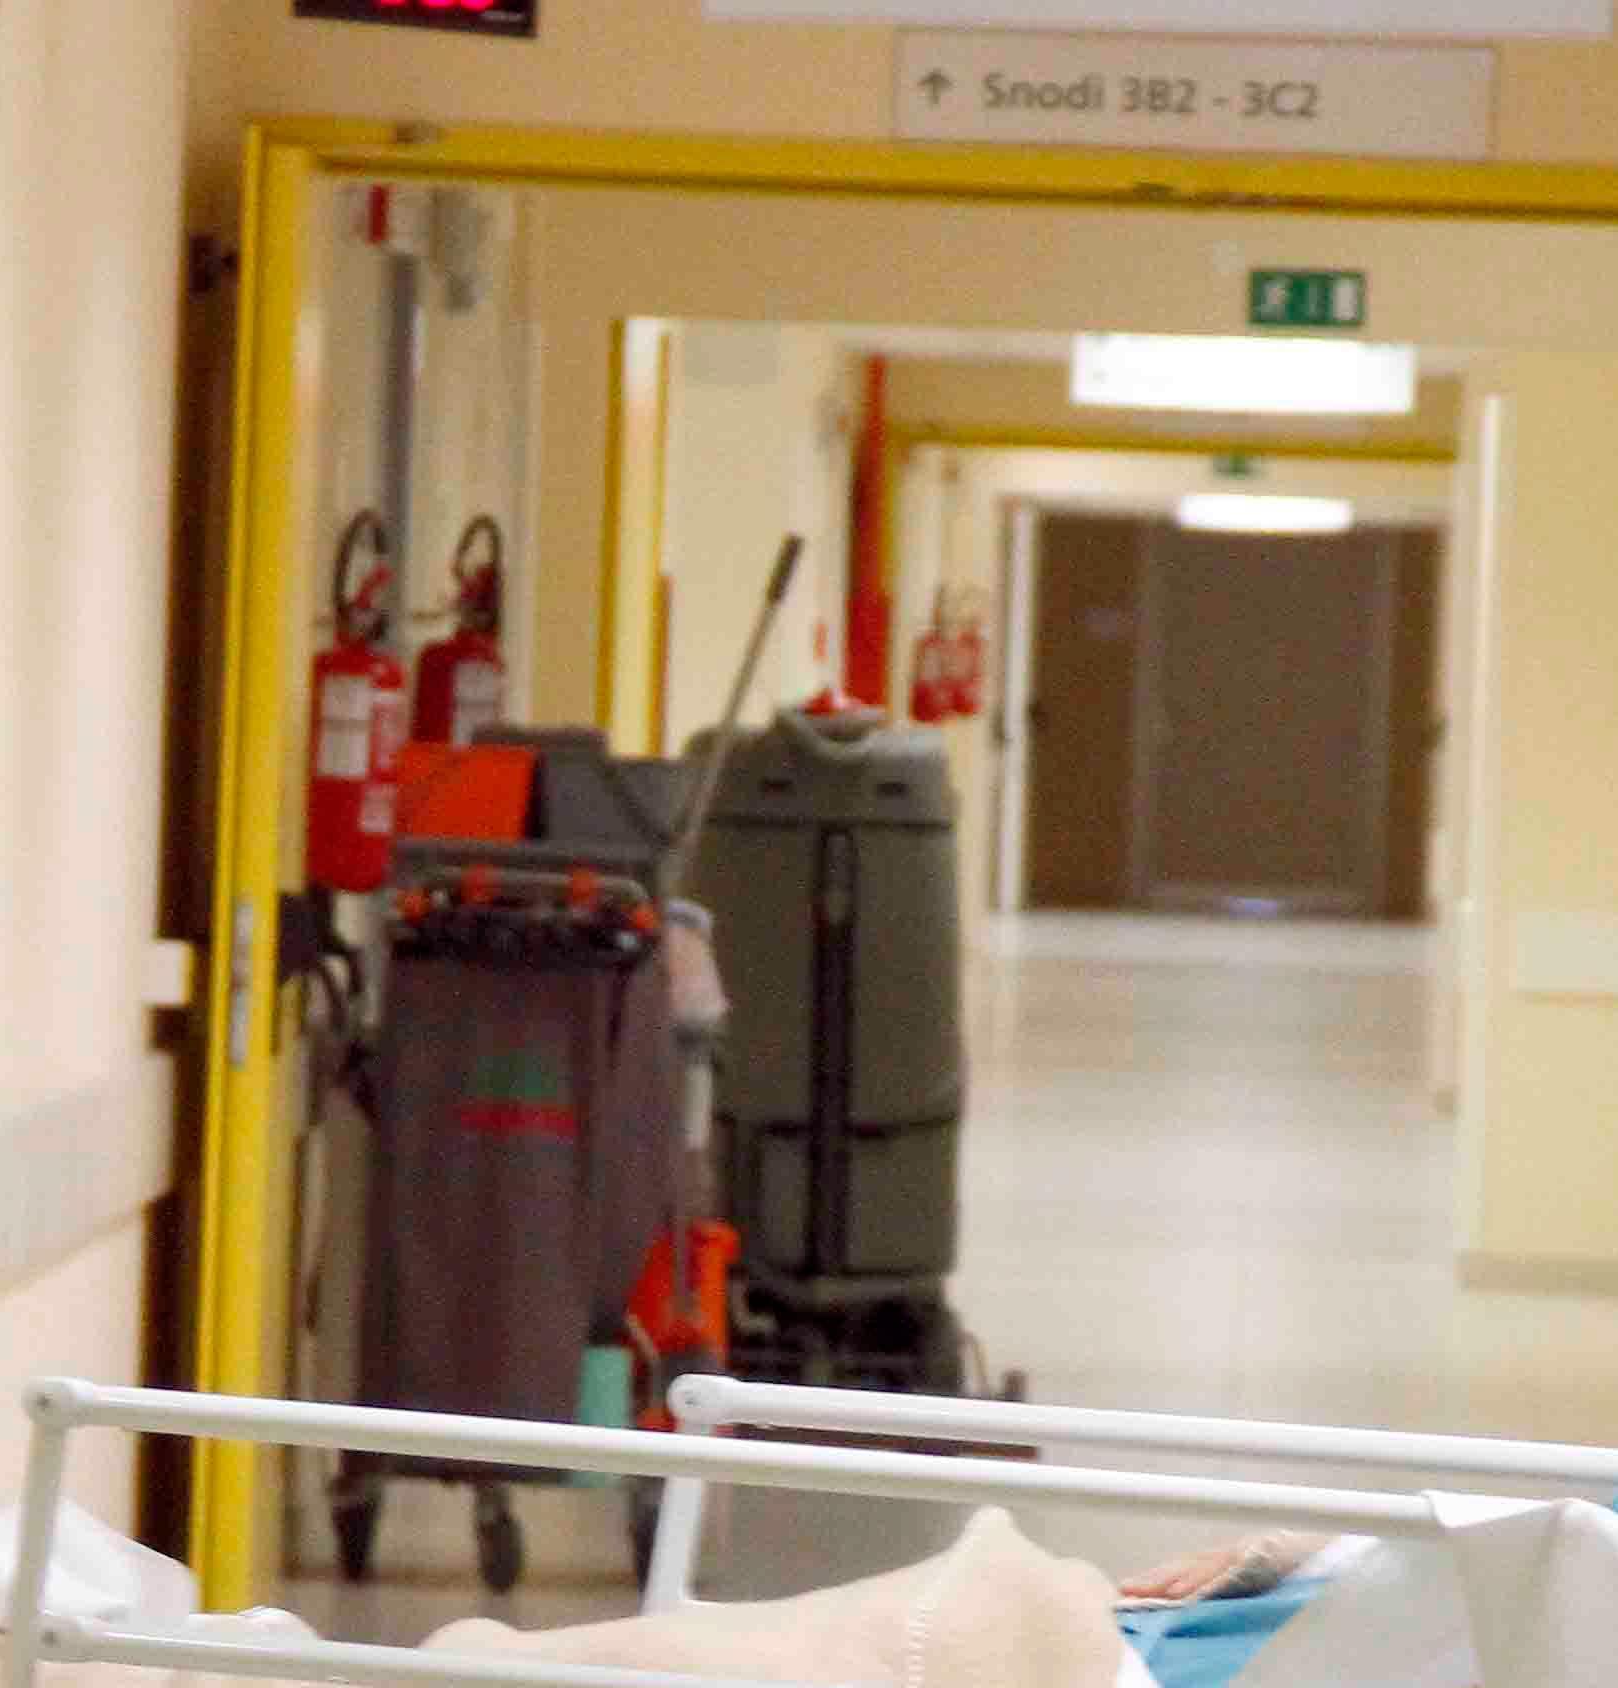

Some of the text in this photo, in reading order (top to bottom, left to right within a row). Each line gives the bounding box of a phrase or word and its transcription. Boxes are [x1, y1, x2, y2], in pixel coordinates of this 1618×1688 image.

[983, 71, 1105, 110] Snodi
[1120, 75, 1198, 116] 3B2
[1242, 78, 1320, 119] 3C2
